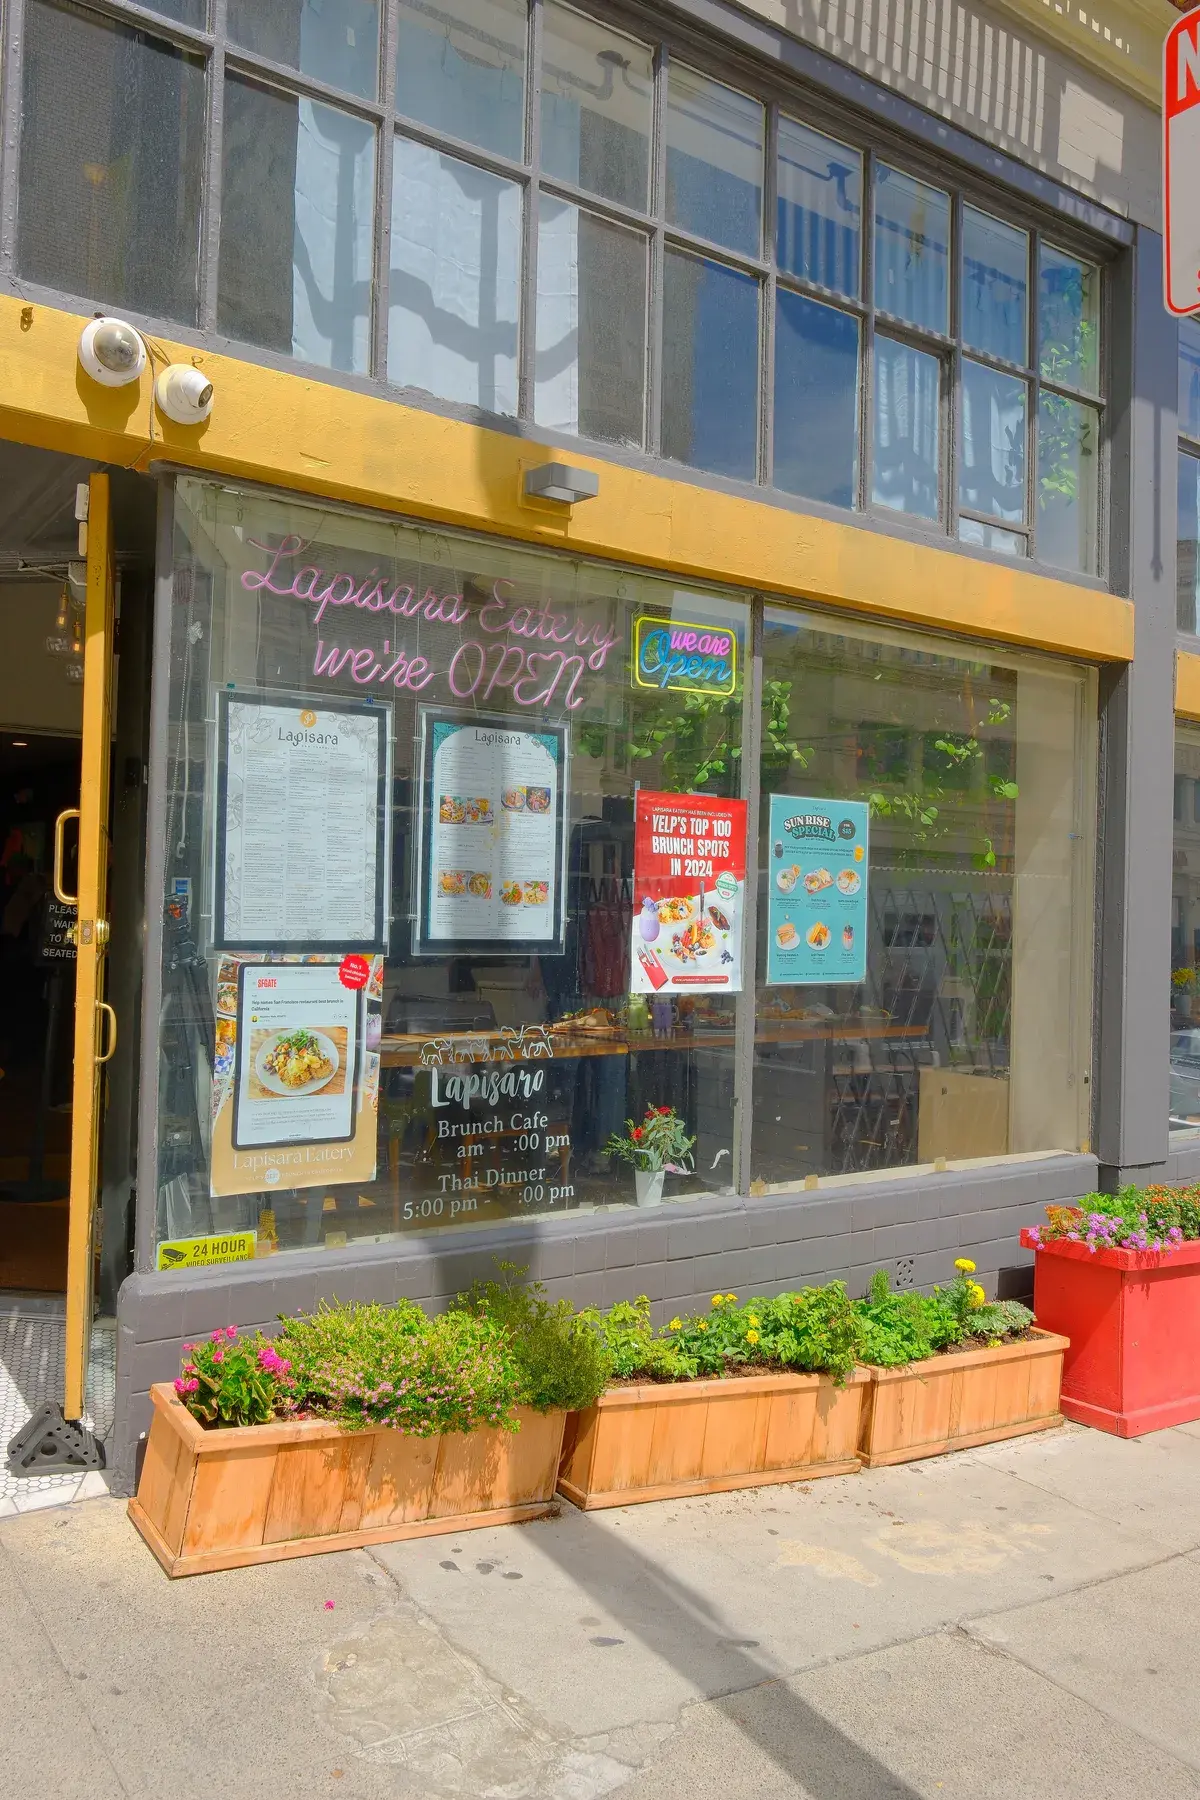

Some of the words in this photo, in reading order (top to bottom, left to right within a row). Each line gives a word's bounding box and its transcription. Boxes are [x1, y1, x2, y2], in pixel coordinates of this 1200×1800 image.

[241, 533, 471, 624] Lapisara
[478, 579, 623, 671] Eatery
[670, 631, 697, 651] we
[698, 634, 731, 656] are
[640, 629, 732, 688] Open
[313, 640, 435, 691] we're
[448, 640, 585, 709] OPEN
[278, 726, 339, 746] Lapisara
[474, 729, 521, 746] Lapisara
[652, 814, 687, 835] YELP'S
[690, 817, 709, 836] TOP
[712, 820, 732, 838] 100
[784, 815, 804, 830] SUN
[805, 815, 830, 828] RISE
[791, 826, 836, 841] SPECIAL
[652, 836, 694, 856] BRUNCH
[697, 839, 730, 858] SPOTS
[670, 858, 681, 876] IN
[684, 859, 713, 878] 2024
[49, 904, 78, 916] PLEAS
[54, 919, 75, 929] WAIT
[50, 933, 62, 943] TO
[43, 947, 77, 959] SEATED
[257, 978, 277, 988] SFGATE
[438, 1115, 504, 1138] Brunch
[510, 1111, 549, 1132] Cafe
[457, 1143, 484, 1159] am
[545, 1134, 571, 1154] pm
[233, 1151, 302, 1172] Lapisara
[305, 1146, 356, 1163] Eatery
[438, 1170, 479, 1193] Thai
[486, 1167, 546, 1187] Dinner
[402, 1197, 444, 1221] 5:00
[450, 1197, 478, 1217] pm
[549, 1184, 575, 1204] pm
[192, 1243, 208, 1258] 24
[212, 1238, 246, 1255] HOUR
